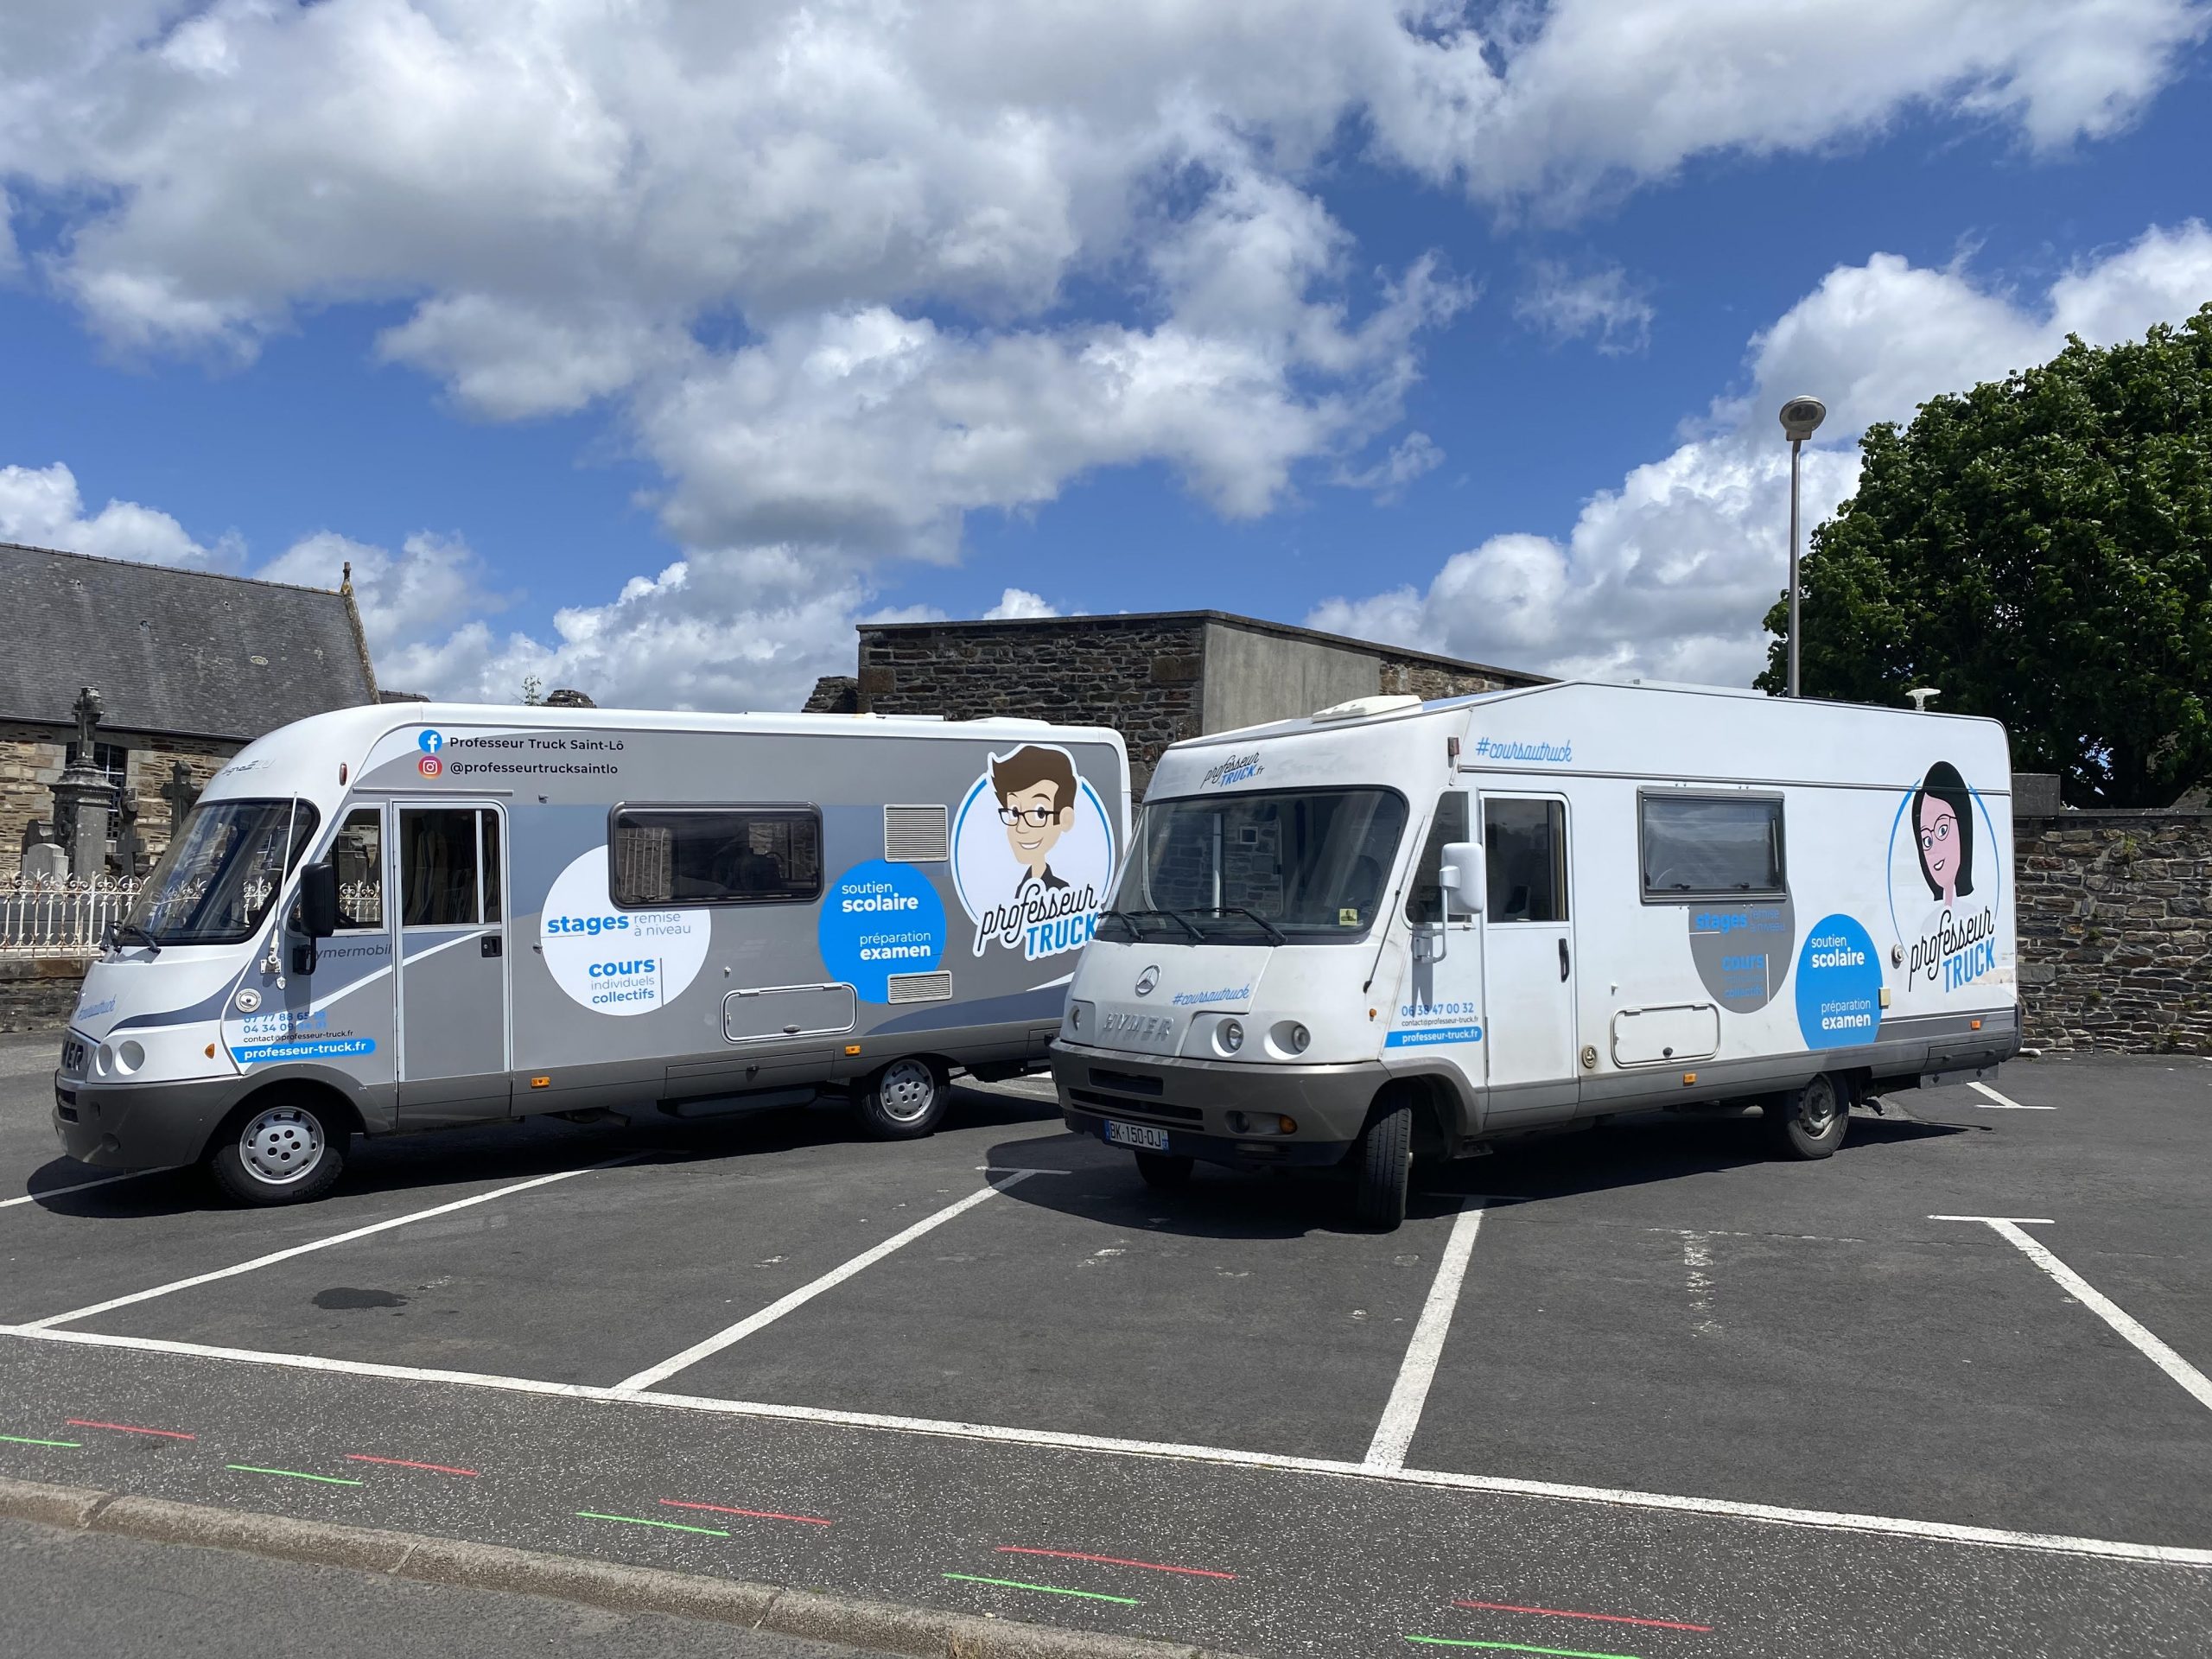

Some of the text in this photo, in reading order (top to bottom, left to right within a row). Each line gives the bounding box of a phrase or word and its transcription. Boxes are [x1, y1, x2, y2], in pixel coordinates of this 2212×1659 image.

[449, 737, 625, 751] Professeur Truck Saint-Lô
[1475, 737, 1573, 762] #coursautruck
[449, 761, 619, 775] @professeurtrucksaintlo
[1199, 752, 1260, 790] professeur
[841, 880, 893, 895] soutien
[842, 893, 919, 913] scolaire
[547, 913, 681, 936] stages remise
[976, 883, 1098, 952] professeur
[1695, 912, 1749, 935] stages
[633, 925, 691, 937] à niveau
[859, 930, 931, 947] préparation
[1026, 912, 1099, 957] TRUCK
[1811, 934, 1847, 948] soutien
[1908, 905, 1995, 993] professeur
[306, 944, 392, 961] ymermobil
[859, 944, 931, 961] examen
[1811, 947, 1866, 968] scolaire
[588, 958, 656, 978] cours
[1720, 954, 1765, 972] cours
[1942, 937, 1996, 994] TRUCK
[590, 976, 655, 991] individuels
[592, 988, 655, 1004] collectifs
[1172, 983, 1250, 1006] #coursautruck
[1402, 1002, 1474, 1016] 06 38 47 00 32
[1821, 998, 1872, 1015] préparation
[263, 1014, 276, 1022] 77
[278, 1013, 294, 1021] 88
[1103, 1013, 1175, 1036] HYMER
[1821, 1014, 1872, 1030] examen
[243, 1025, 259, 1033] 04
[262, 1024, 276, 1033] 34
[279, 1022, 295, 1031] 09
[1402, 1029, 1478, 1045] professeur-truck.fr
[244, 1041, 366, 1061] professeur-truck.fr
